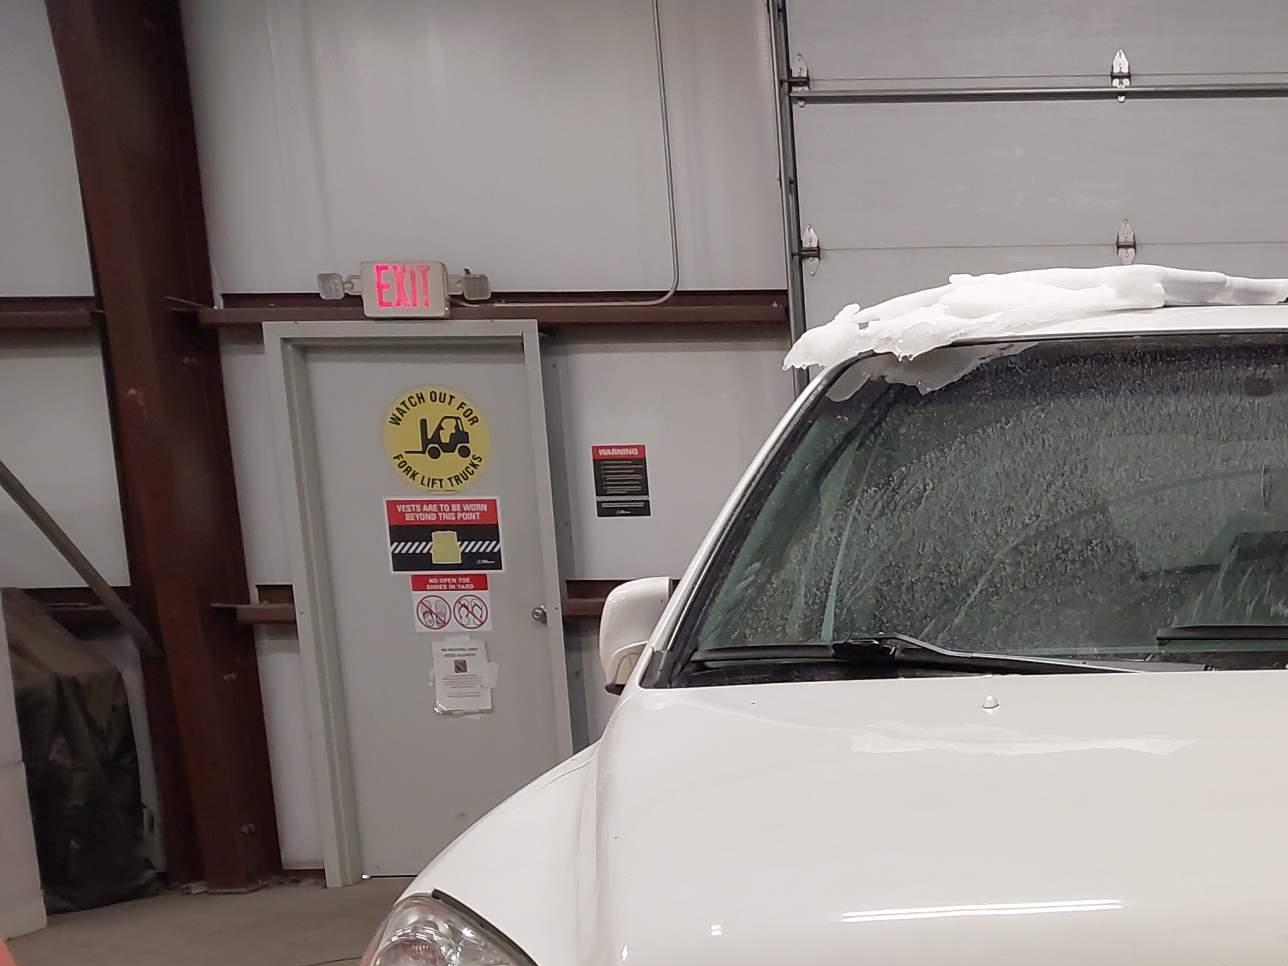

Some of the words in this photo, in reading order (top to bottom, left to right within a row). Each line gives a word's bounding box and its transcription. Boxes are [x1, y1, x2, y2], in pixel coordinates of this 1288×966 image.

[374, 264, 431, 309] EXIT
[388, 392, 425, 426] WATCH
[429, 390, 455, 406] OUT
[456, 401, 480, 426] FOR
[598, 448, 639, 456] WARNING
[392, 454, 419, 481] FORK
[420, 475, 444, 489] LIFT
[447, 454, 483, 488] TRUCKS
[396, 504, 421, 512] VESTS
[422, 504, 438, 512] ARE
[440, 504, 451, 512] TO
[451, 504, 462, 512] BE
[462, 503, 488, 511] WORN
[405, 513, 437, 521] BEYOND
[438, 512, 456, 520] THIS
[457, 512, 481, 520] POINT
